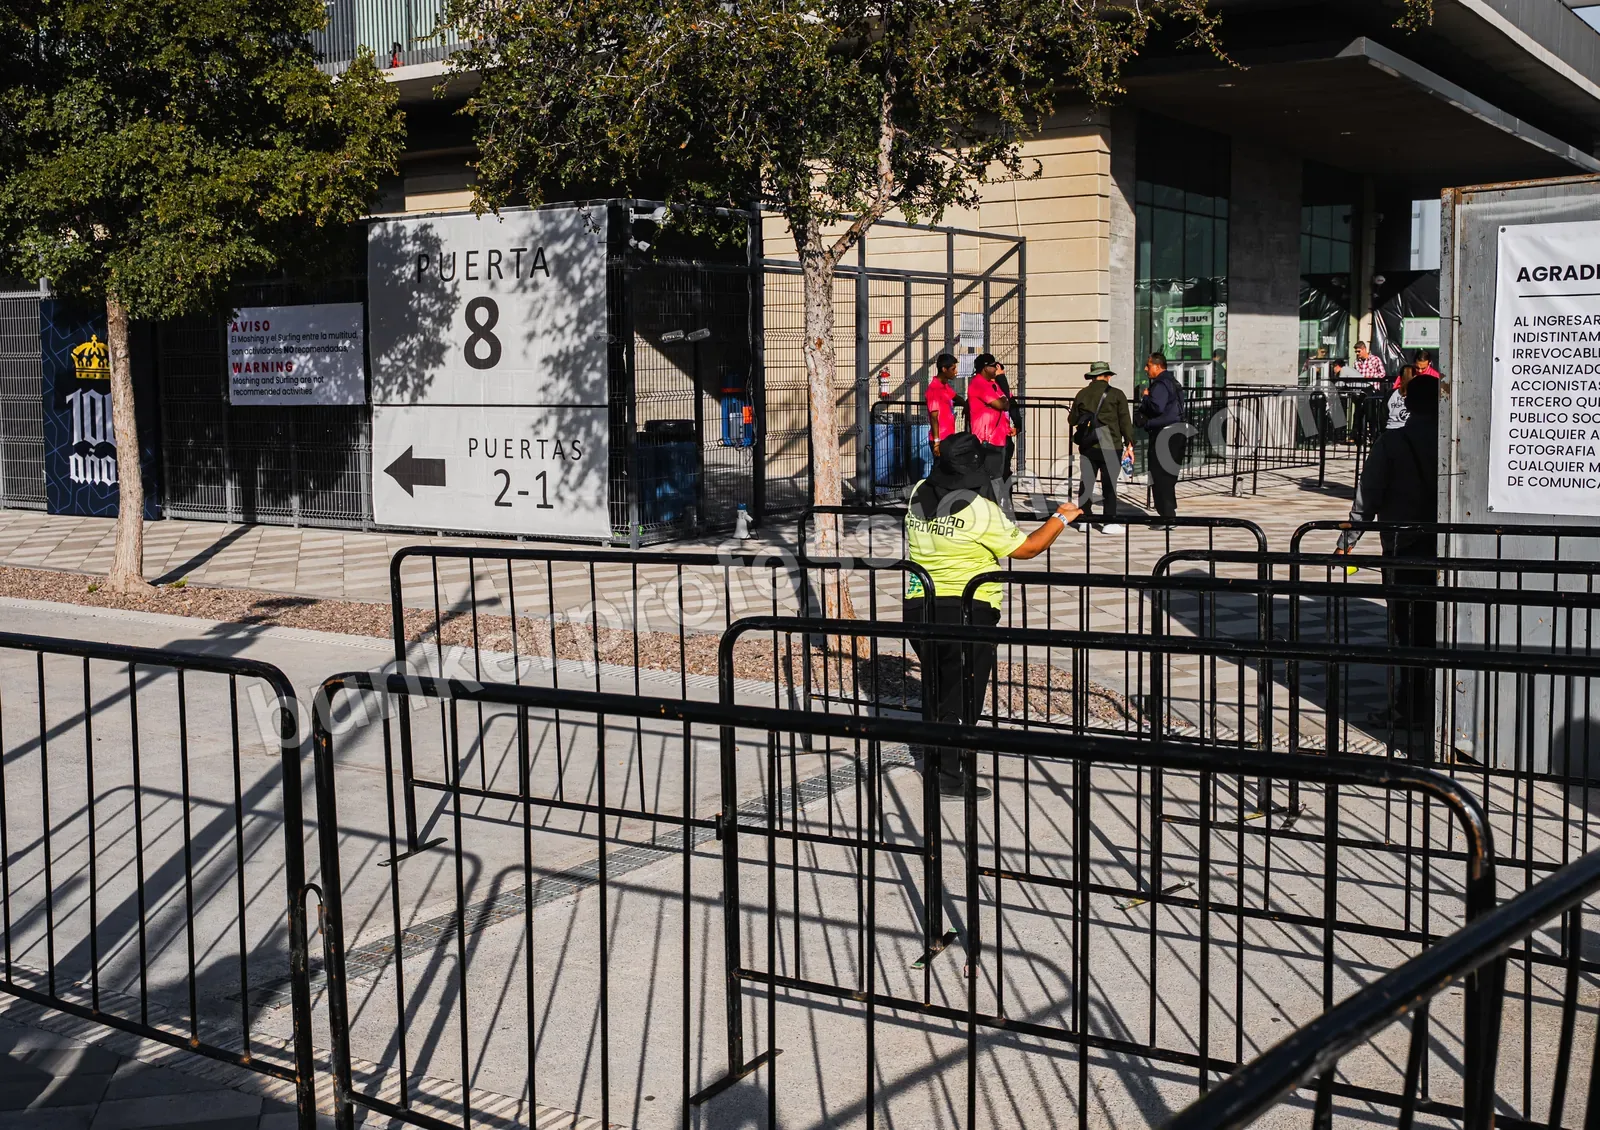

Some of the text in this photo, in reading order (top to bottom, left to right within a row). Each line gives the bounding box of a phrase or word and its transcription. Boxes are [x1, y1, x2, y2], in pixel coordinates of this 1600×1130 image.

[416, 247, 551, 283] PUERTA
[1516, 264, 1600, 282] AGRAD
[231, 320, 270, 332] AVISO
[1513, 314, 1600, 327] AL INGRESAR
[238, 334, 264, 344] Moshing
[265, 336, 270, 344] y
[271, 333, 276, 341] el
[278, 332, 300, 343] Surfing
[463, 296, 502, 370] 8
[1513, 331, 1600, 343] INDISTINTAM
[244, 346, 282, 354] actividades
[283, 345, 294, 354] NO
[1512, 347, 1600, 359] IRREVOCABL
[232, 361, 293, 374] WARNING
[233, 376, 259, 386] Moshing
[261, 376, 274, 384] and
[276, 376, 299, 386] Surfing
[313, 375, 324, 383] not
[1511, 380, 1600, 391] ACCIONISTA
[233, 386, 312, 395] recommended activities
[1511, 396, 1600, 409] TERCERO QU
[1509, 412, 1568, 424] PUBLICO
[1508, 428, 1586, 441] CUALQUIER
[468, 437, 582, 461] PUERTAS
[1508, 444, 1596, 456] FOTOGRAFIA
[69, 447, 119, 486] año
[1507, 460, 1585, 473] CUALQUIER
[493, 468, 554, 509] 2-1
[1507, 476, 1600, 489] DE COMUNIC
[908, 519, 955, 537] PRIVADA
